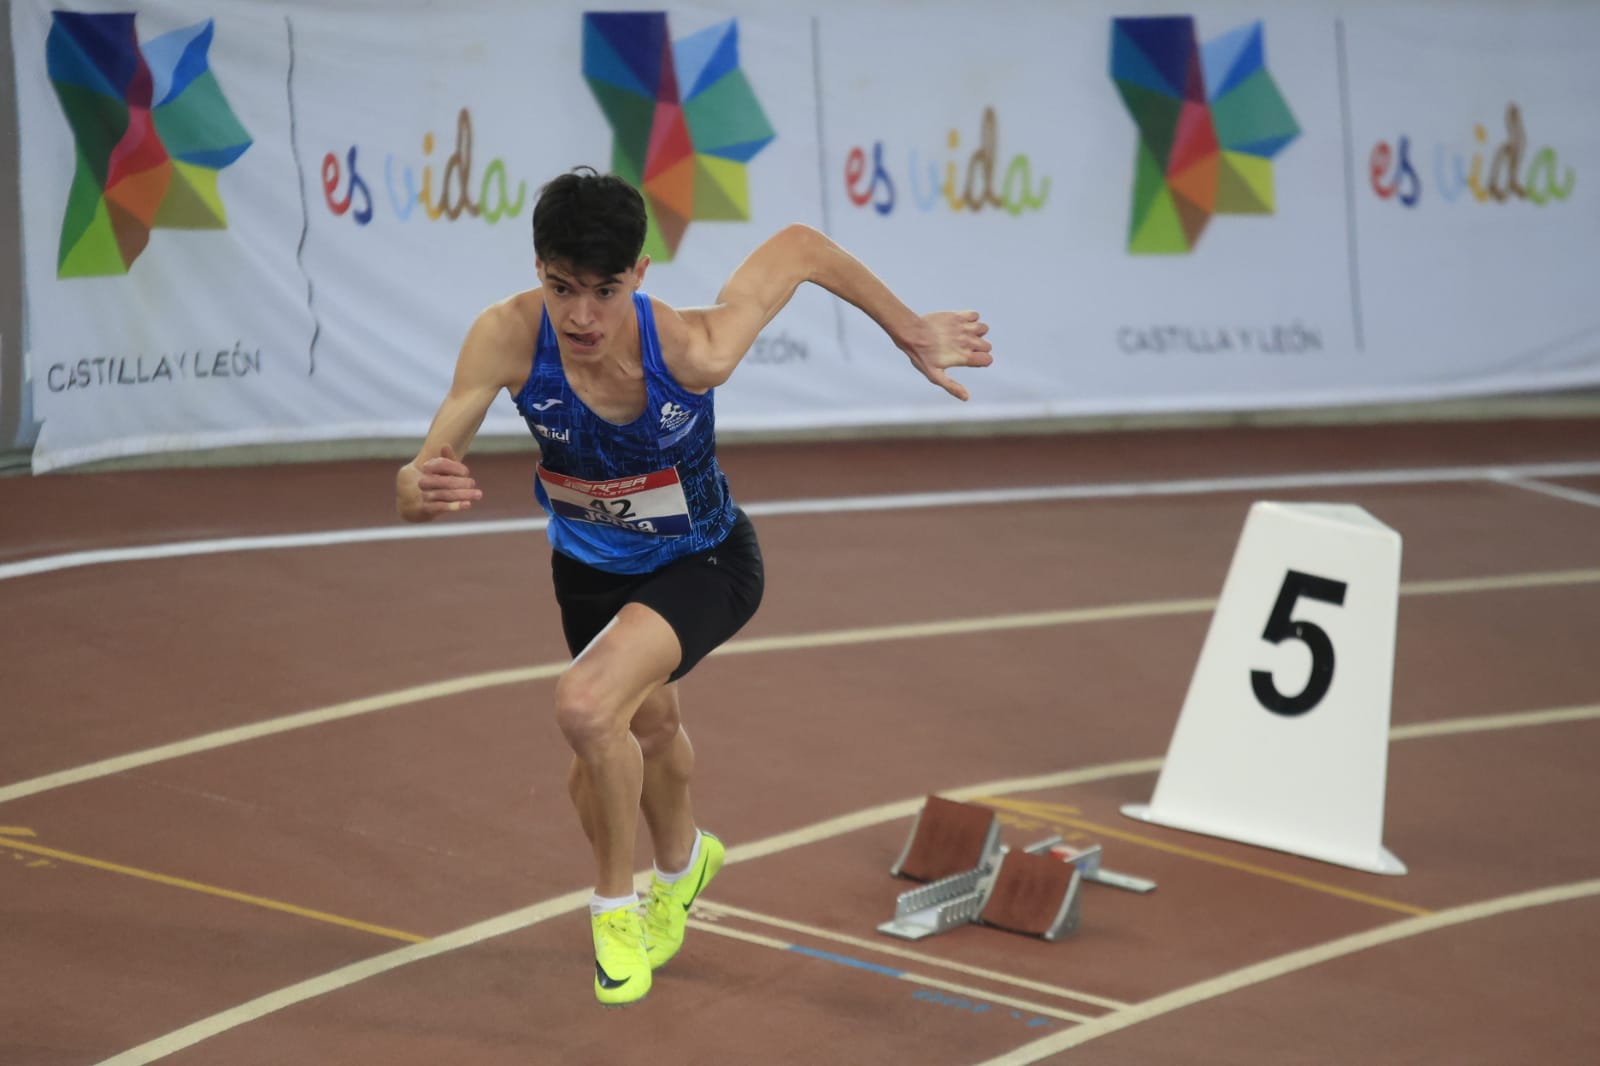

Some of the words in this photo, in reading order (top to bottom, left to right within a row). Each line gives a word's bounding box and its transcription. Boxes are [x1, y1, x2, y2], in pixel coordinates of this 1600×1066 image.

[321, 145, 373, 226] es
[385, 106, 526, 224] vida
[845, 141, 896, 216] es
[909, 103, 1050, 216] vida
[1369, 135, 1421, 208] es
[1433, 100, 1576, 207] vida
[47, 357, 173, 393] CASTILLA
[193, 340, 261, 378] LEÓN
[746, 331, 808, 364] EÓN
[1116, 325, 1235, 355] CASTILLA
[1257, 318, 1324, 353] LEÓN
[1250, 569, 1348, 717] 5
